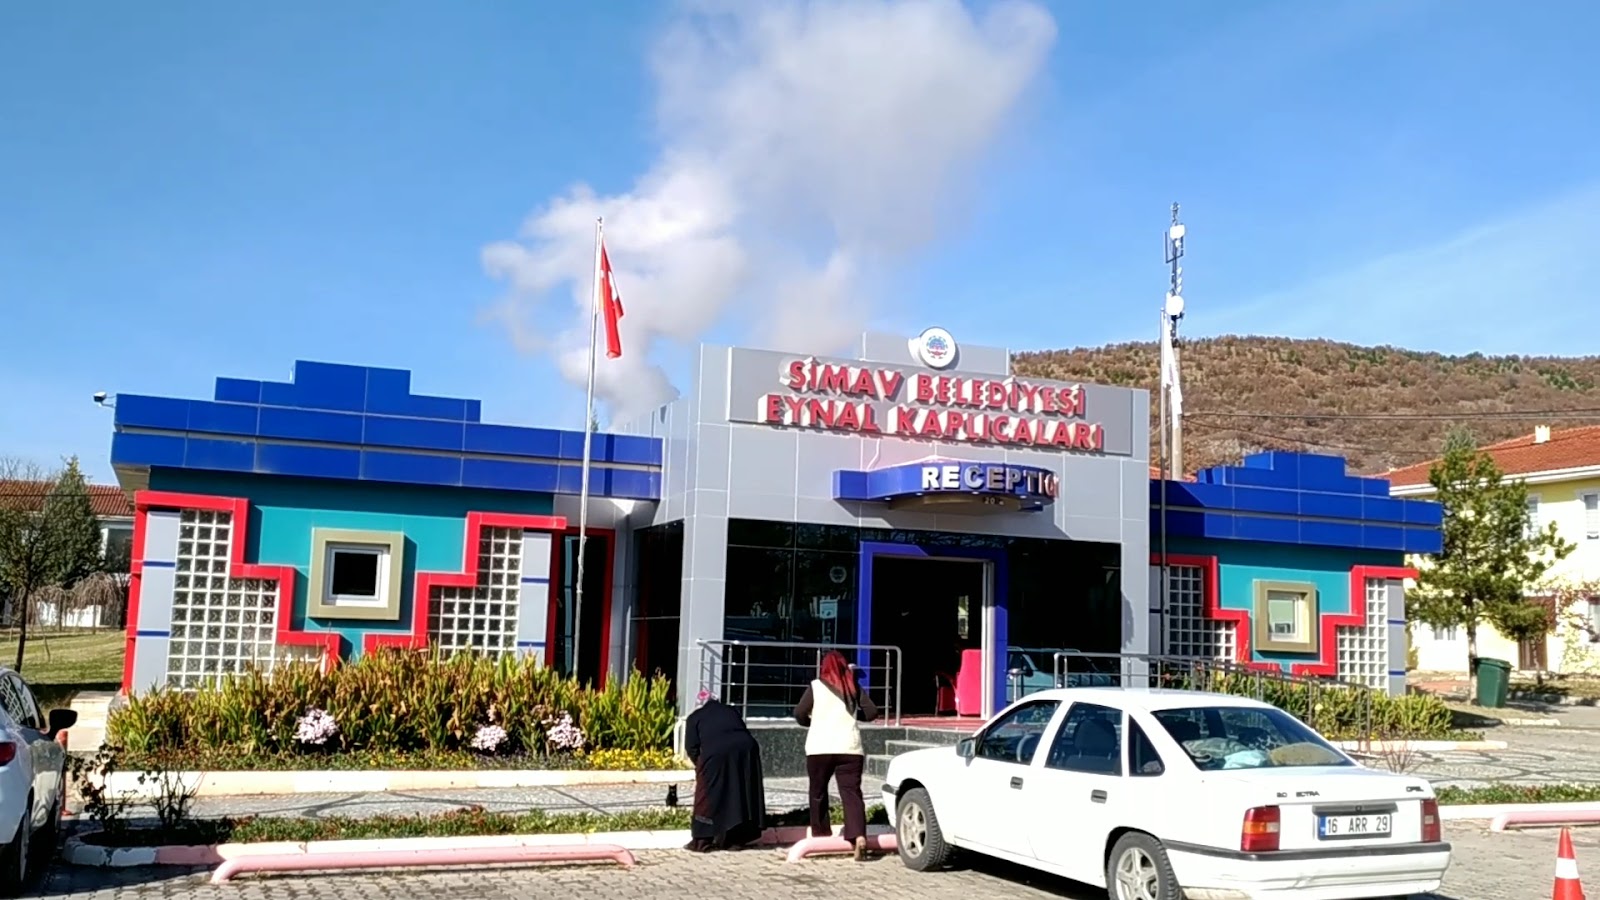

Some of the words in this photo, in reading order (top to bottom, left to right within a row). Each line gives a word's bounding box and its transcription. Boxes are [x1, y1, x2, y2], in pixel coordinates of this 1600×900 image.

[785, 356, 903, 398] SİMAV
[913, 373, 1086, 416] BELEDİYESİ
[763, 394, 879, 431] EYNAL
[893, 402, 1104, 449] KAPLICALARI
[1327, 818, 1338, 834] 16
[1348, 817, 1368, 833] ARR
[1375, 815, 1388, 832] 29
